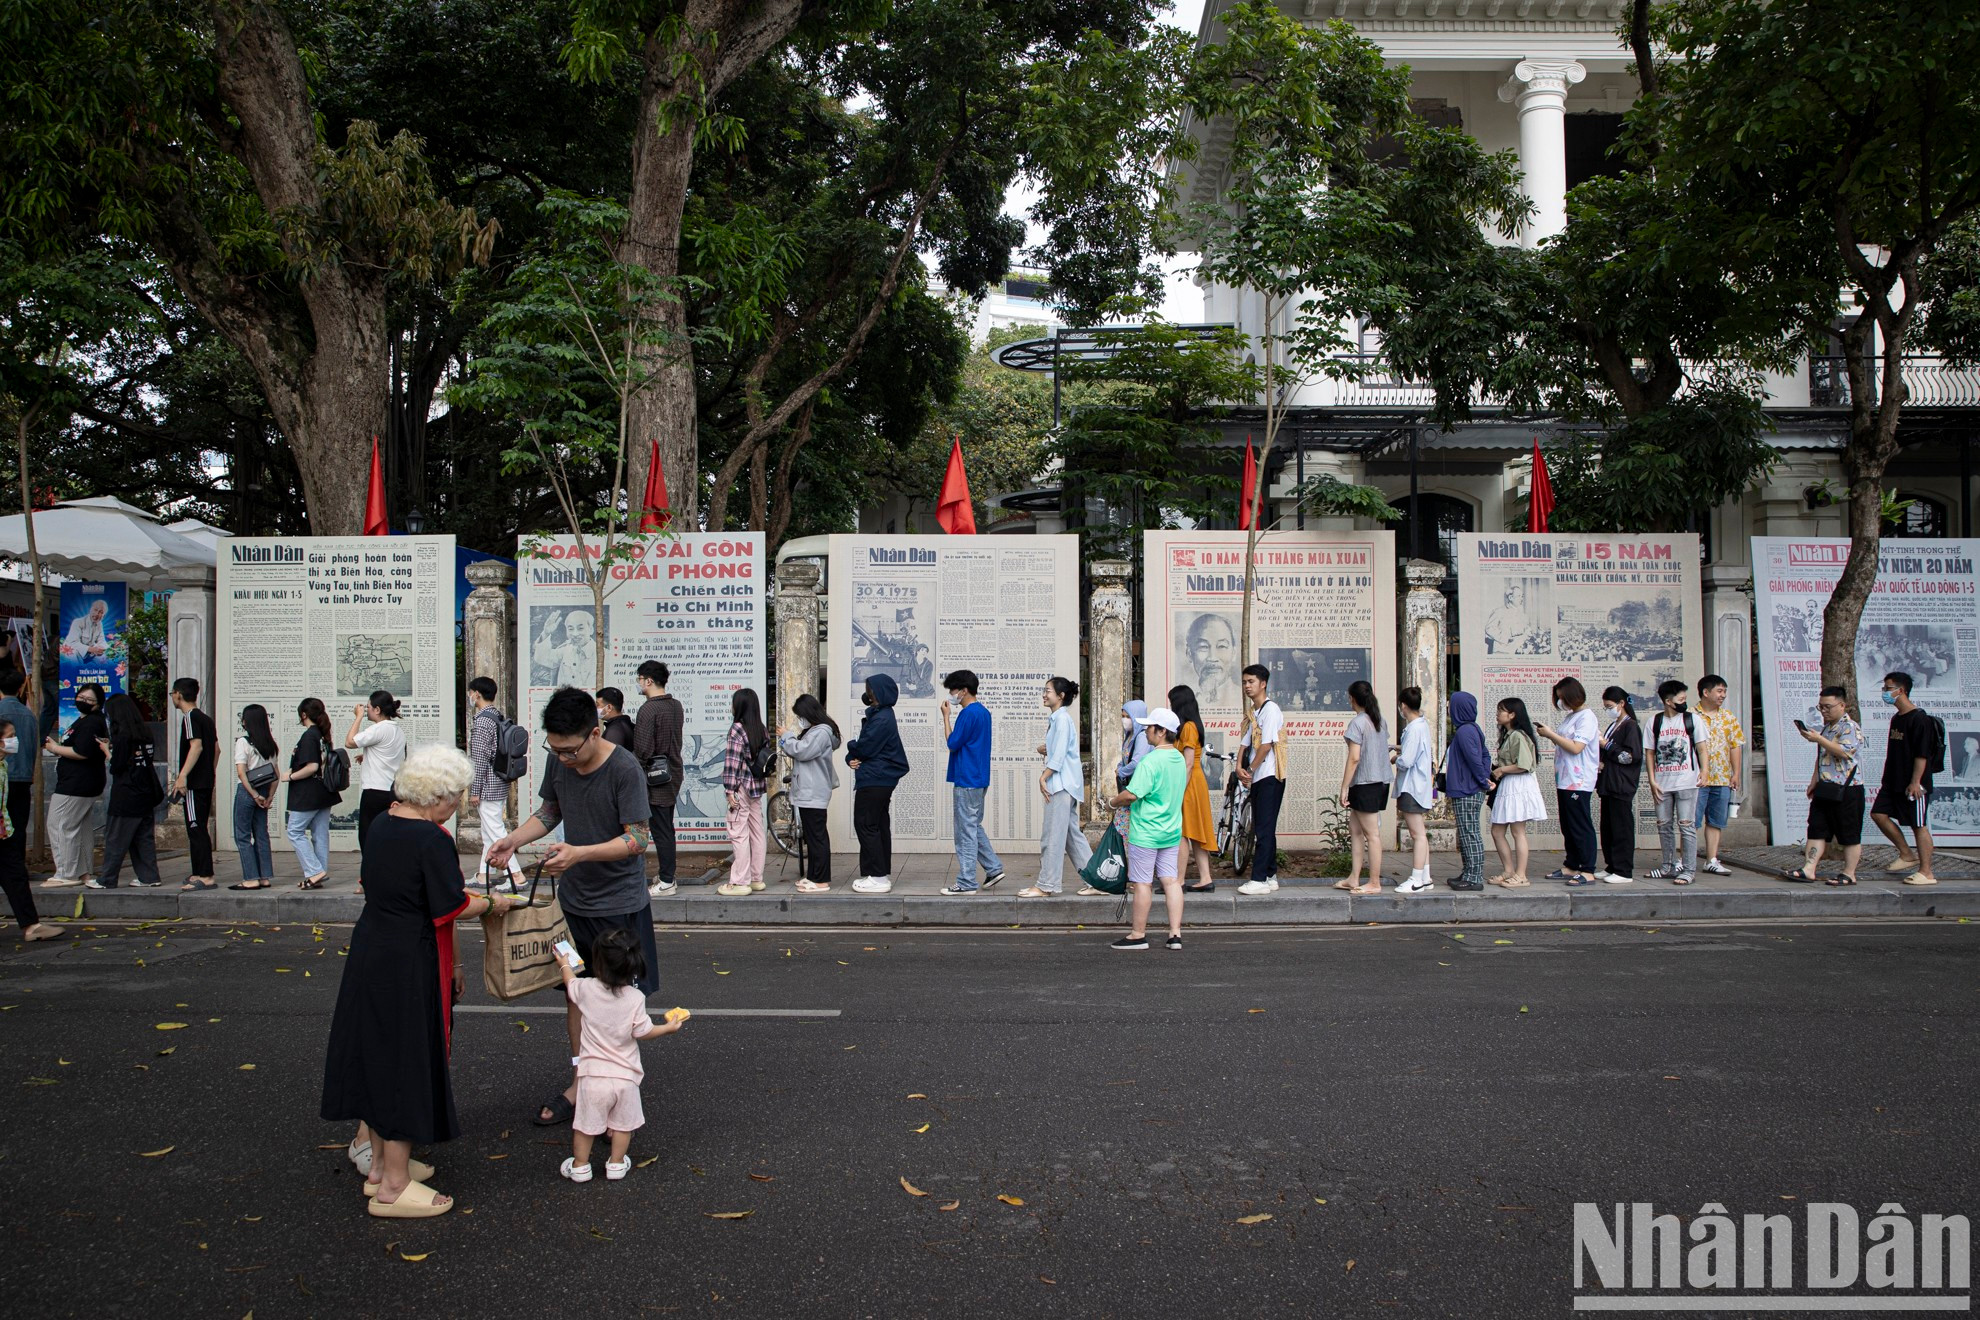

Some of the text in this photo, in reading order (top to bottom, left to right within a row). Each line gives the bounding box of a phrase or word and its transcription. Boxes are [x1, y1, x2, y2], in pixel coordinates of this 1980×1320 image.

[232, 545, 303, 561] Nhân Dân
[611, 541, 645, 559] Ô
[656, 541, 691, 558] SÀI
[703, 540, 752, 557] GÒN
[870, 548, 906, 562] Nhân
[910, 548, 936, 562] Dân
[1478, 540, 1551, 558] Nhân Dân
[1586, 542, 1671, 560] 15 NĂM
[1791, 546, 1833, 561] Nhân
[309, 553, 412, 564] Giải phóng hoàn toàn
[1202, 551, 1366, 564] 10 NĂM ẠI THẮNG MÙA XUÂN
[1891, 556, 1922, 574] NIỆM
[1927, 559, 1942, 573] 20
[1945, 556, 1972, 573] NĂM
[309, 567, 319, 577] thị
[325, 567, 336, 576] xã
[341, 567, 360, 576] Biên
[391, 567, 412, 577] cảng
[611, 562, 751, 580] GIẢI PHÓNG
[1187, 575, 1224, 591] Nhân
[1258, 575, 1371, 587] MÍT-TINH LỚN Ở HÀ NỘI
[1769, 577, 1975, 595] GIẢI PHÓNG MIỀN GÀY QUỐC TẾ LAO ĐỘNG 1-5
[291, 590, 302, 599] 1-5
[671, 585, 753, 596] Chiến dịch
[319, 594, 402, 604] và tỉnh Phước Tuy
[657, 602, 753, 612] Hồ Chí Minh
[657, 616, 753, 631] toàn thắng
[1269, 661, 1283, 671] 1-5
[512, 941, 538, 960] HELLO
